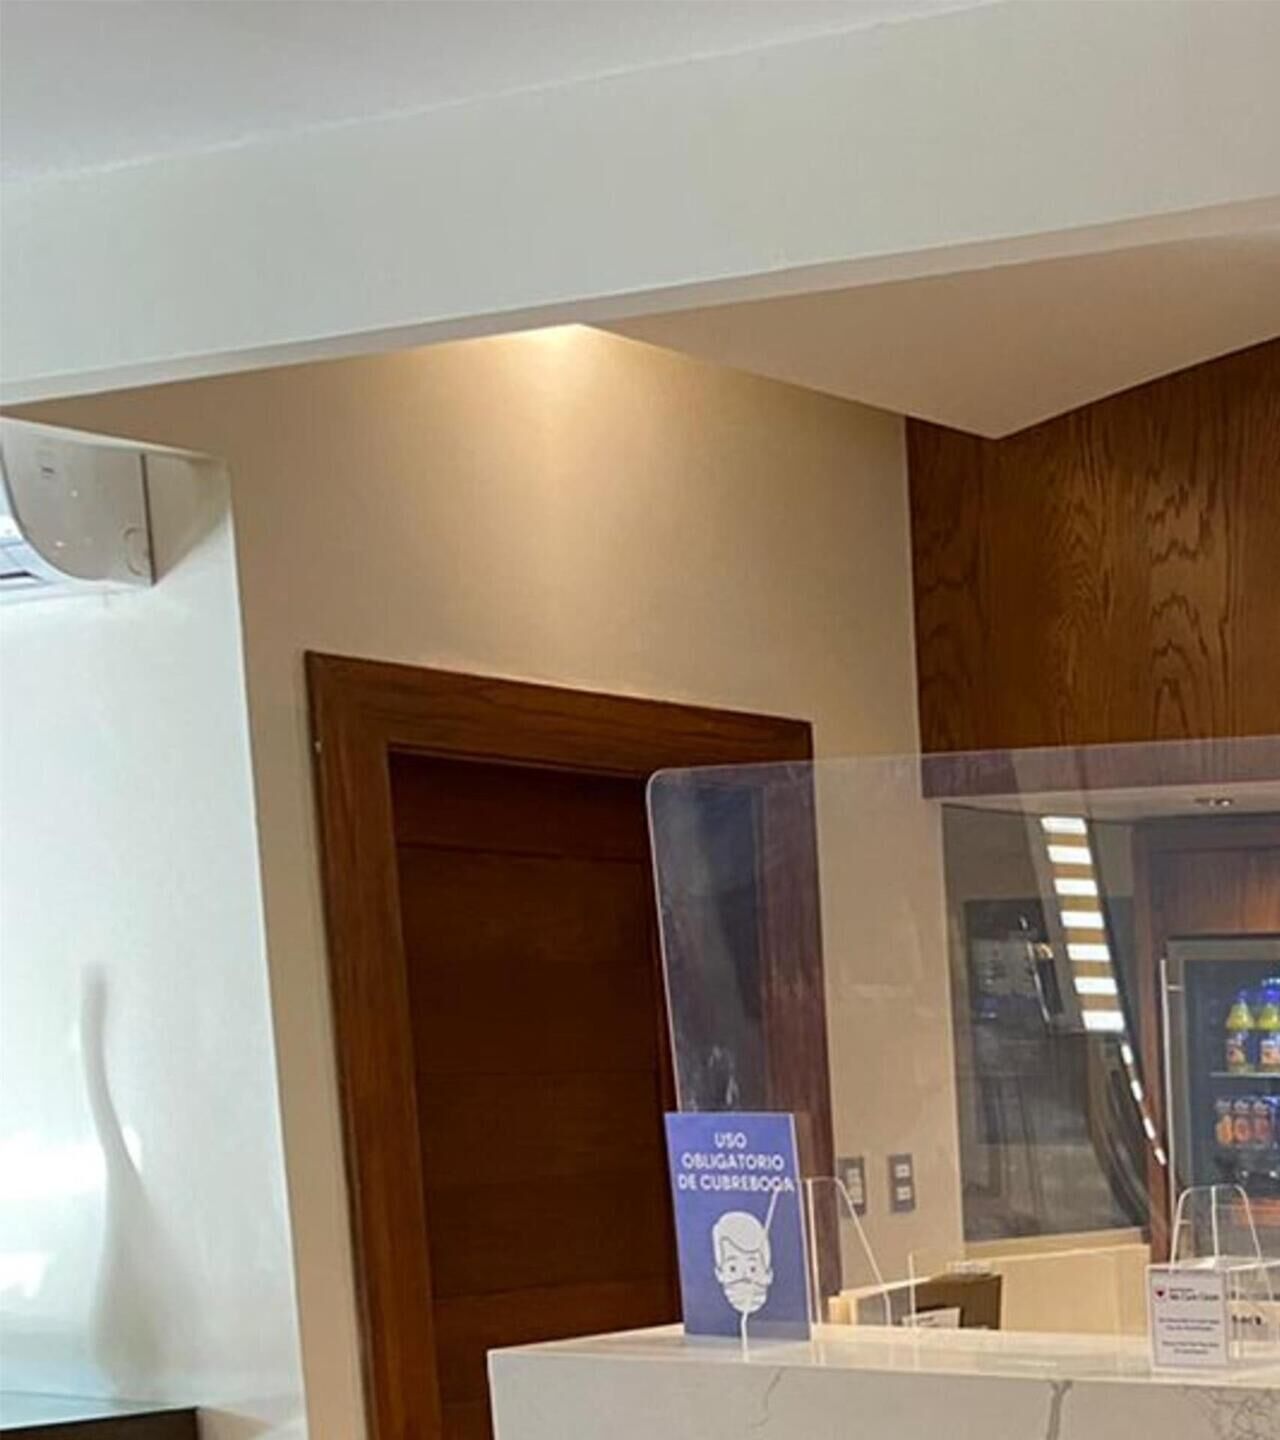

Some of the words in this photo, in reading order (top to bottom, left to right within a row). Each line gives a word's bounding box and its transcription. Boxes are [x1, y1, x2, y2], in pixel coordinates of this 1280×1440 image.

[714, 1132, 747, 1148] USO
[681, 1153, 785, 1170] OBLIGATORIO
[678, 1175, 697, 1190] DE
